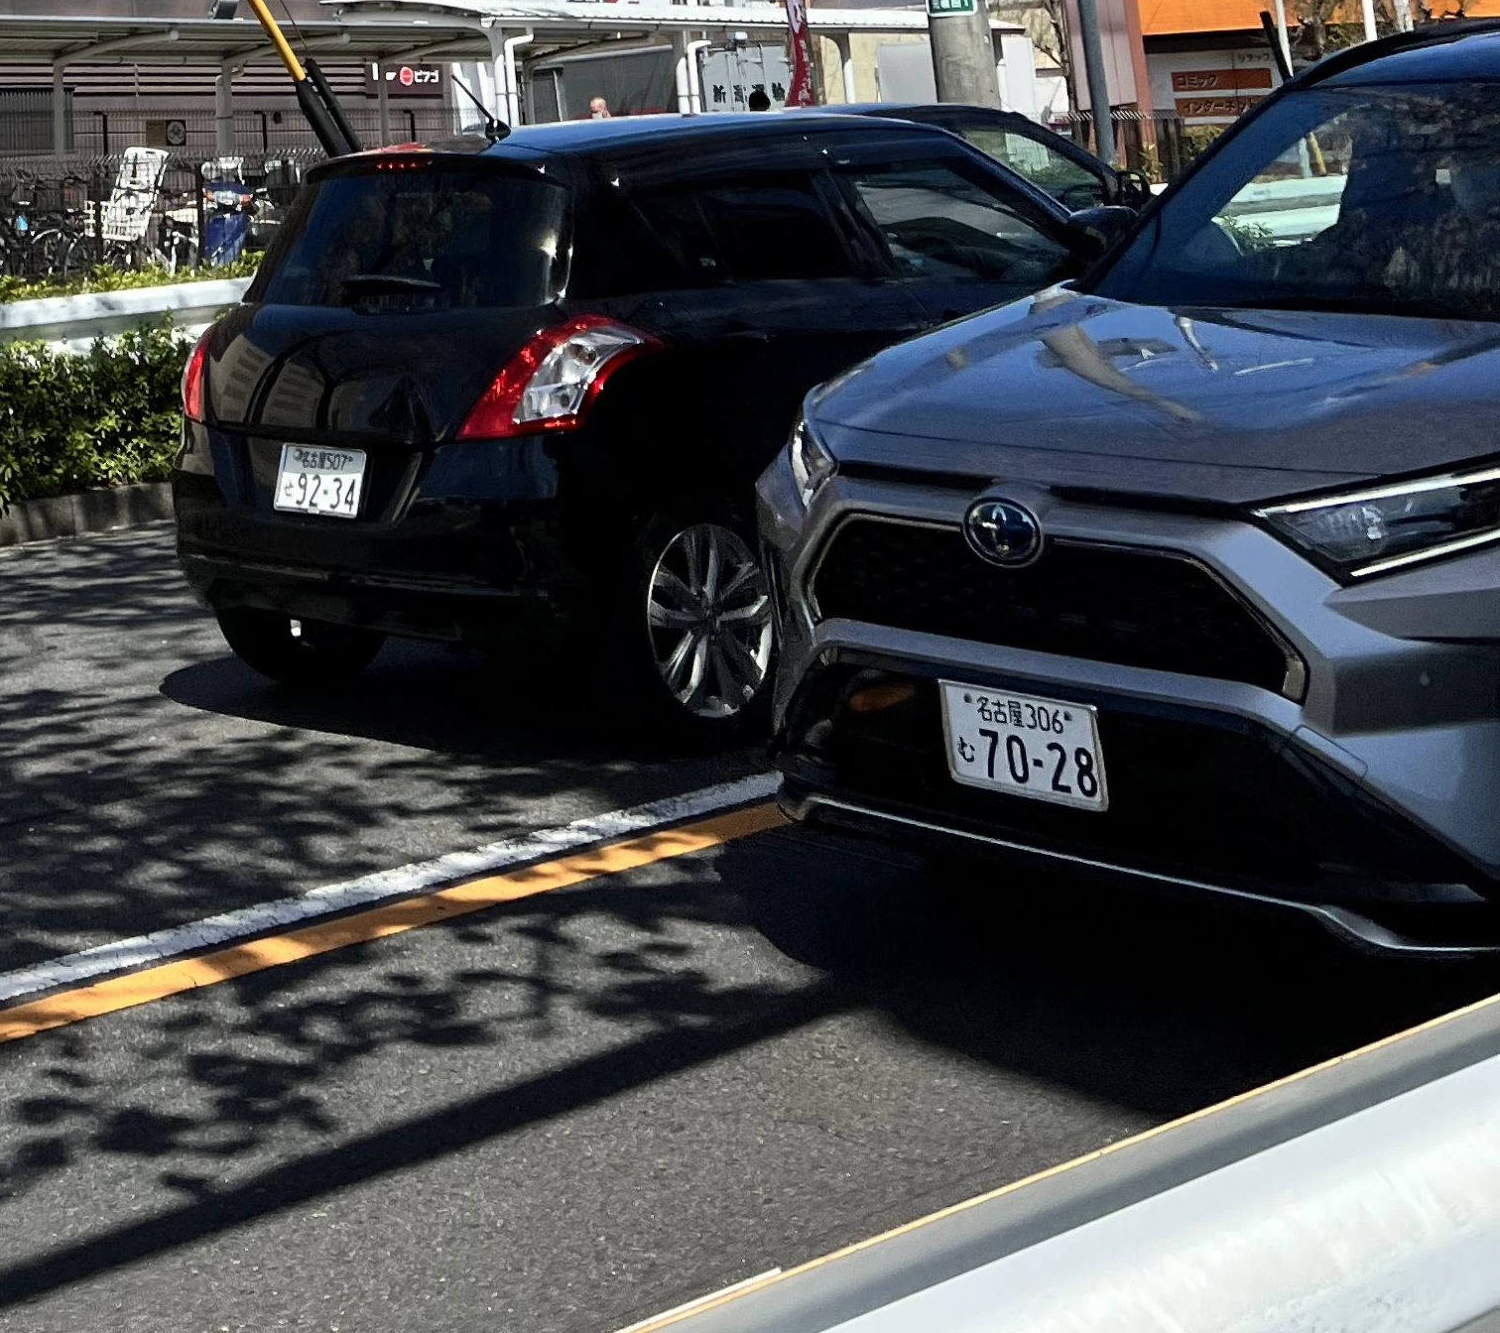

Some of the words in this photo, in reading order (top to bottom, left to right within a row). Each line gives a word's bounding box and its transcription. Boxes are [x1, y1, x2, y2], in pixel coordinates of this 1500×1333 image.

[1177, 75, 1219, 89] コミック
[295, 473, 356, 512] 92-34
[957, 735, 976, 763] む
[978, 727, 1099, 798] 70-28
